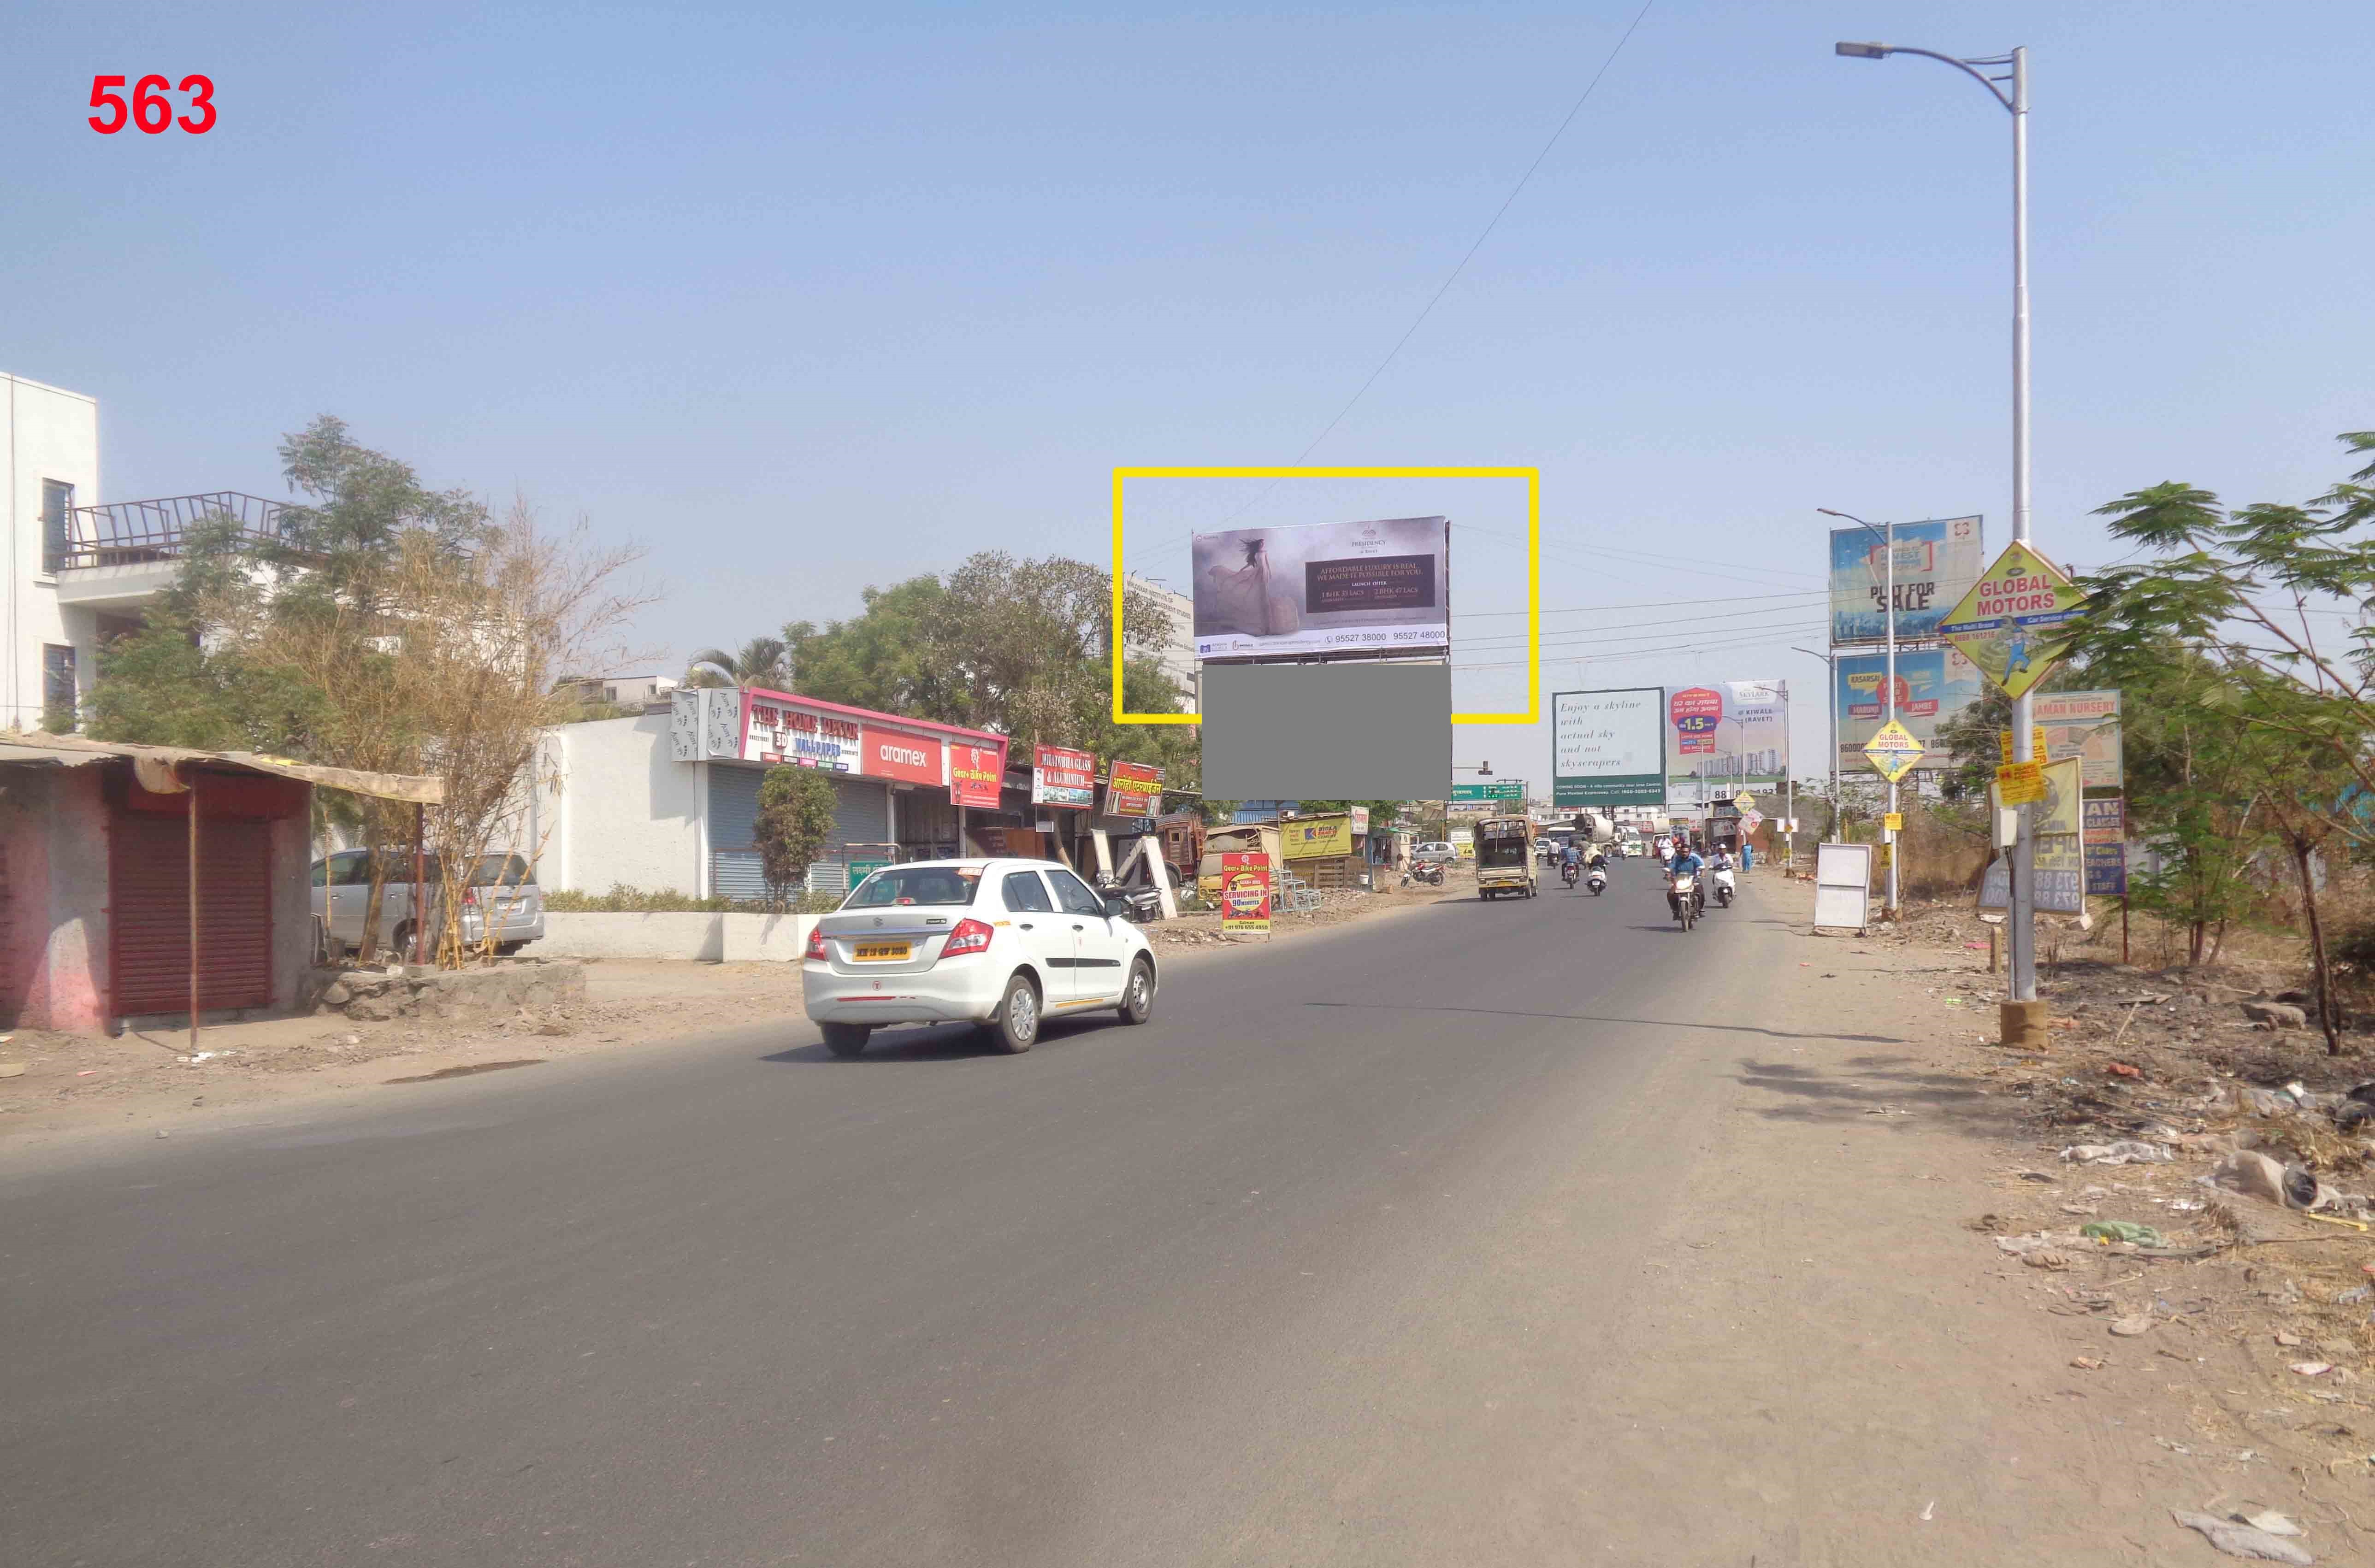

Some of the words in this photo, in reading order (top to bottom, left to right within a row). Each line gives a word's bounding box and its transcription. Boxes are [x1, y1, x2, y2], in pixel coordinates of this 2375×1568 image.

[1320, 565, 1365, 575] AFFORDABLE
[1908, 582, 1935, 596] FOR
[1979, 575, 2051, 597] GLOBAL
[1877, 595, 1929, 613] SALE
[1977, 592, 2055, 617] MOTORS
[1335, 634, 1359, 643] 95527
[1361, 633, 1387, 642] 38000
[1420, 631, 1446, 639] 48000
[1560, 703, 1590, 714] Enjoy
[1604, 700, 1641, 711] skyline
[2069, 701, 2115, 713] NURSERY
[752, 704, 779, 727] THE
[783, 710, 818, 733] HOME
[1560, 716, 1583, 726] with
[1685, 717, 1705, 731] 1.5
[1560, 730, 1594, 740] actual
[1597, 730, 1615, 740] sky
[775, 733, 788, 747] 3D
[795, 737, 840, 757] WALLPAPER
[1560, 744, 1580, 754] and
[1584, 745, 1601, 753] not
[880, 744, 927, 767] aramex
[1075, 758, 1091, 772] GLASS
[1560, 759, 1621, 770] skyscrapers
[969, 769, 982, 780] Bike
[982, 771, 997, 782] Point
[1047, 770, 1052, 783] &
[1054, 771, 1085, 787] ALUMINIUM
[1224, 890, 1259, 899] SERVICING
